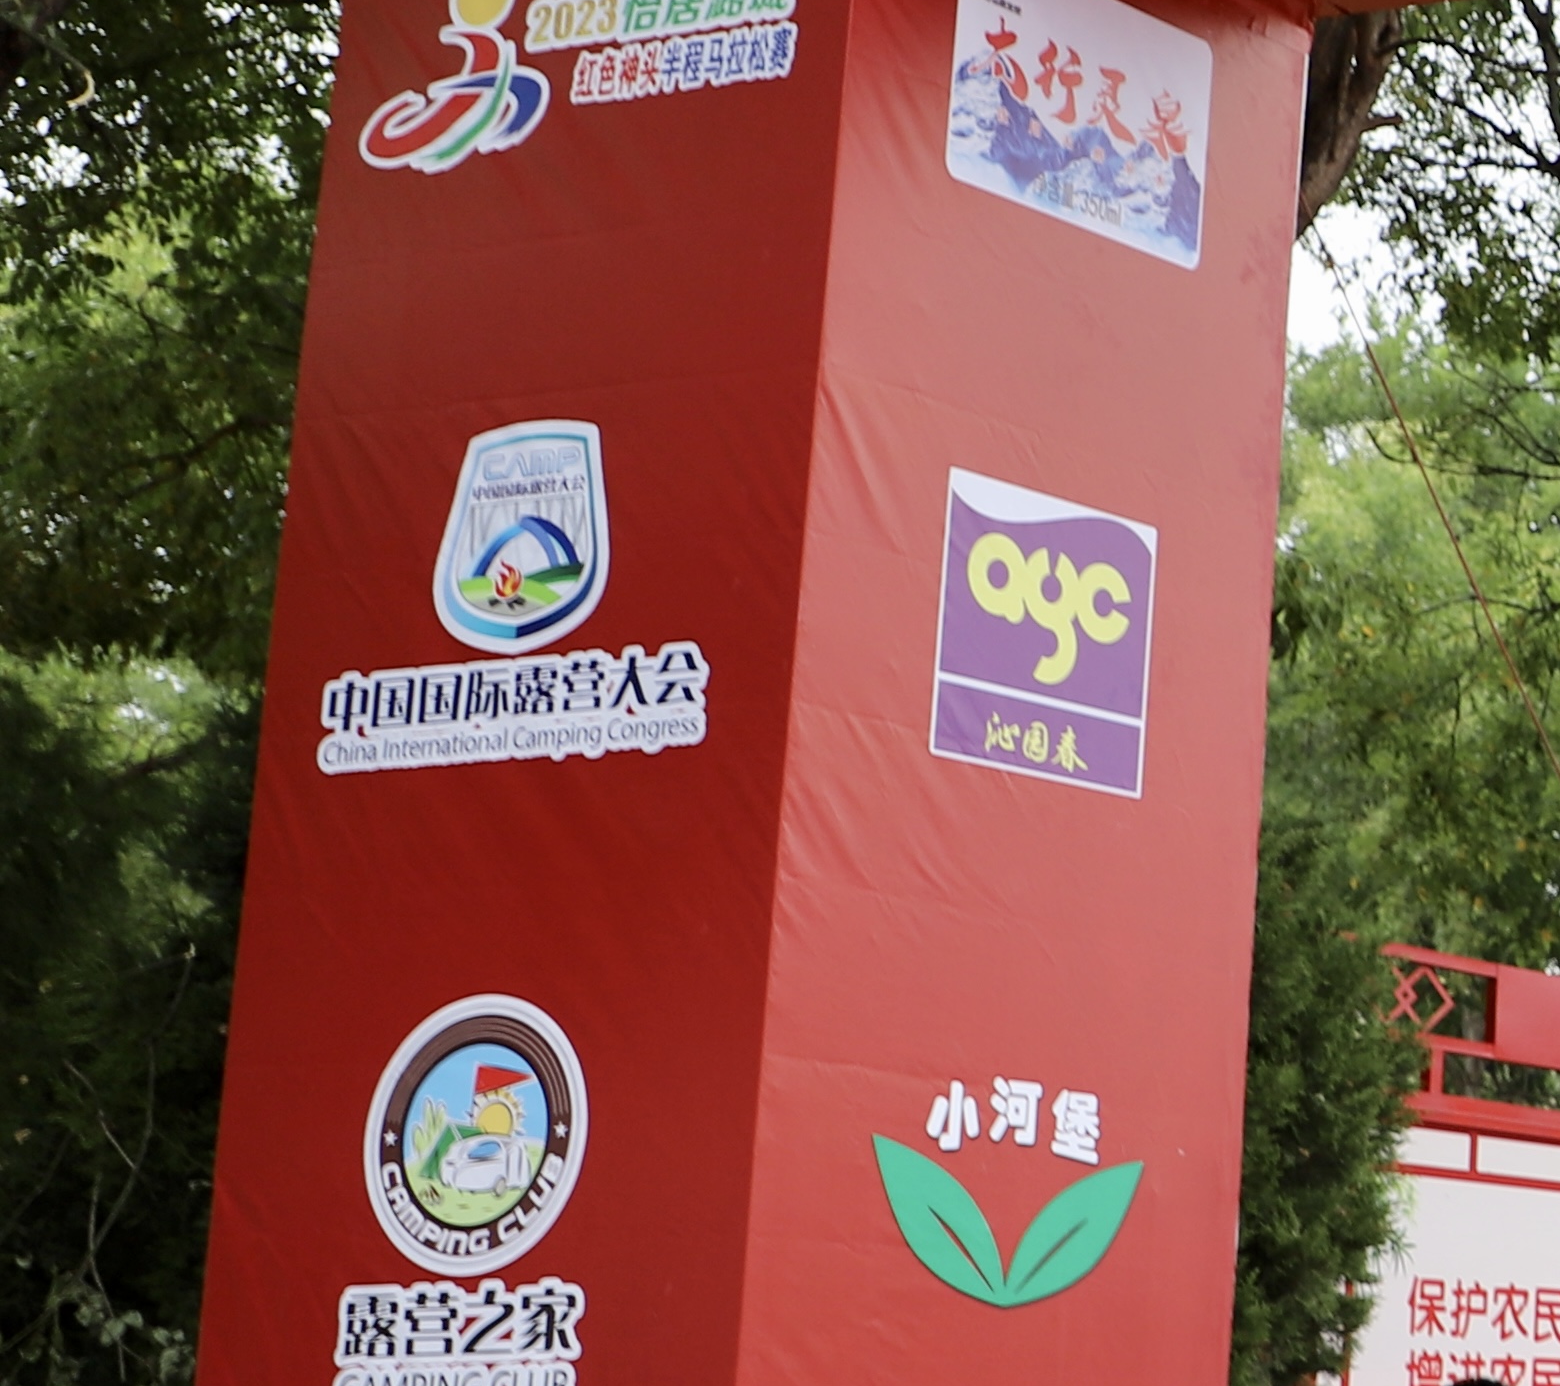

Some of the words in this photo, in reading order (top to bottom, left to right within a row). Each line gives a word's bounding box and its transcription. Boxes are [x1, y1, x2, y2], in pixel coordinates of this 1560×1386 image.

[573, 26, 794, 98] 红色神头半程马拉松赛
[472, 475, 586, 501] 中国国际露营大会
[482, 445, 583, 482] CAMP
[328, 649, 699, 733] 中国国际露营大会
[322, 737, 378, 767] China
[382, 726, 508, 760] International
[513, 720, 603, 756] Camping
[607, 714, 700, 751] Congress
[984, 710, 1089, 774] 沁园春
[925, 1074, 1101, 1166] 小河堡
[381, 1162, 491, 1256] CAMPING
[496, 1153, 566, 1245] CLUB
[344, 1287, 577, 1357] 露营之家
